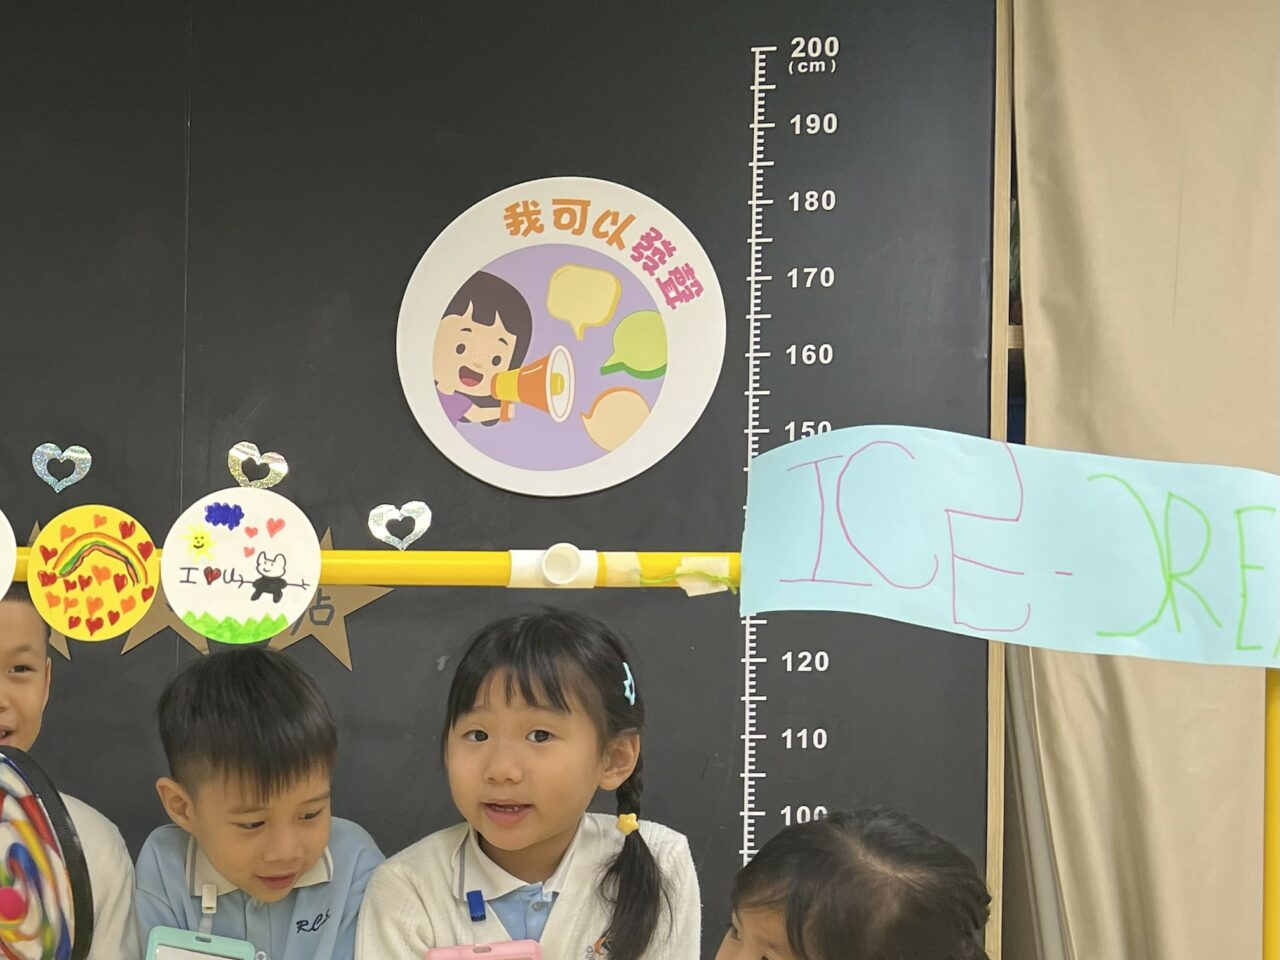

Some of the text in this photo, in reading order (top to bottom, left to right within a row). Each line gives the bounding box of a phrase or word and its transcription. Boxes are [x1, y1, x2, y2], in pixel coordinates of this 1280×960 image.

[790, 36, 840, 58] 200
[789, 112, 839, 135] 190
[788, 189, 837, 212] 180
[503, 198, 704, 310] 我可以發聲
[786, 266, 835, 288] 170
[785, 343, 833, 366] 160
[784, 420, 832, 442] 150
[179, 567, 199, 584] I
[781, 652, 830, 672] 120
[781, 729, 827, 749] 110
